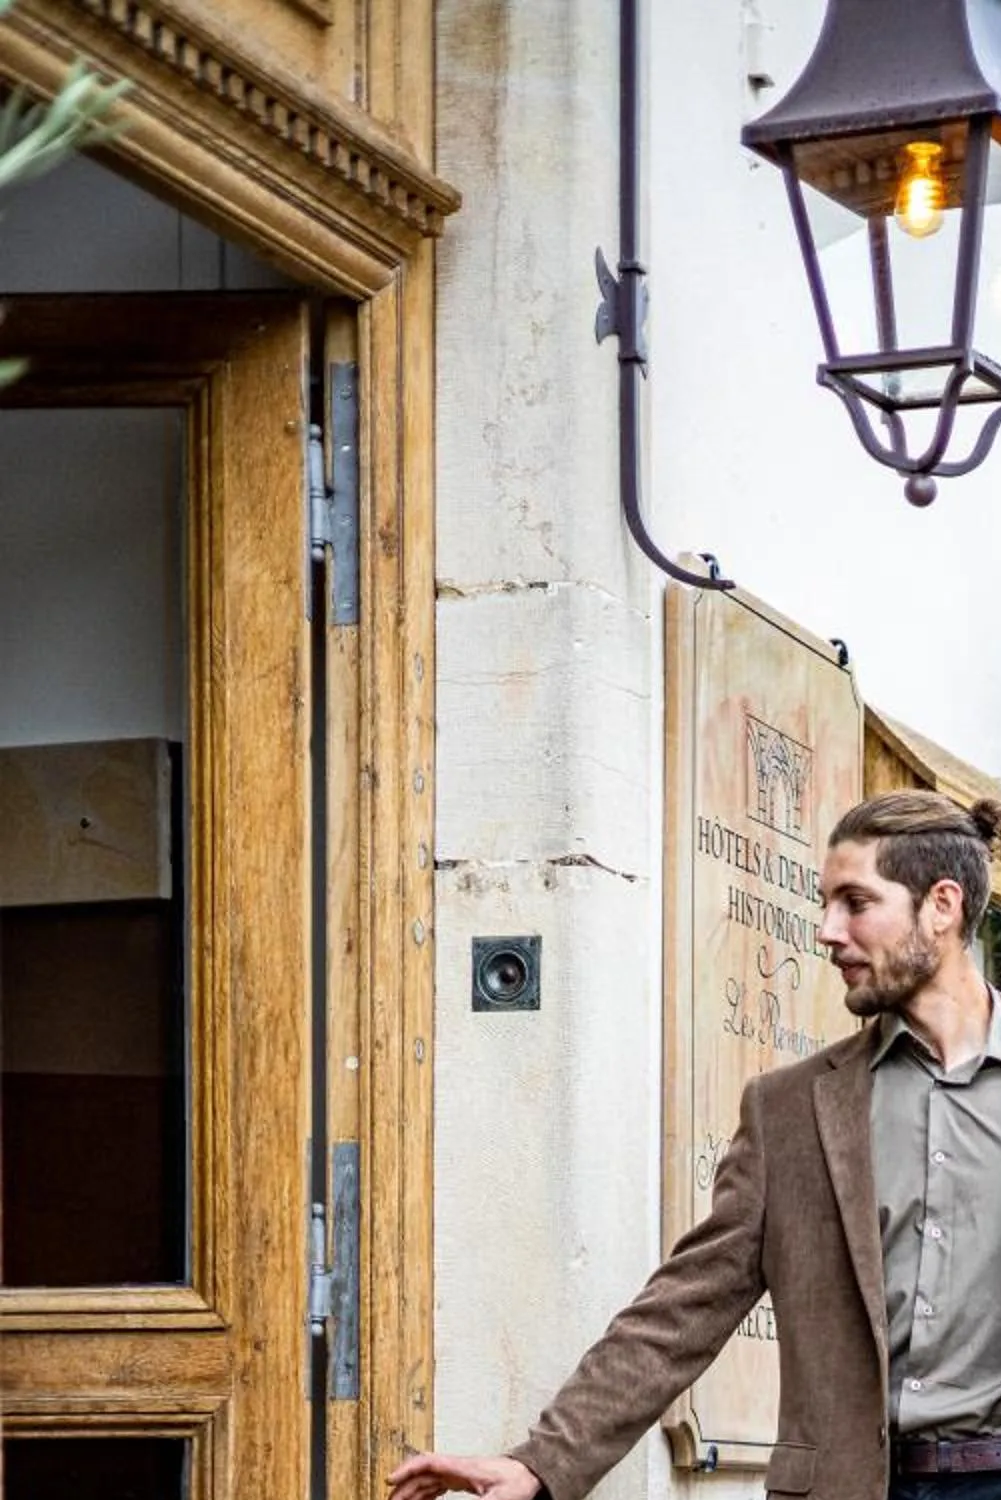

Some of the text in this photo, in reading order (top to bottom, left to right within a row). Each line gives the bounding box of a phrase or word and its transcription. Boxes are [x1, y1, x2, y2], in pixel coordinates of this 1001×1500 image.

[697, 815, 821, 904] HÔTELS & DEME
